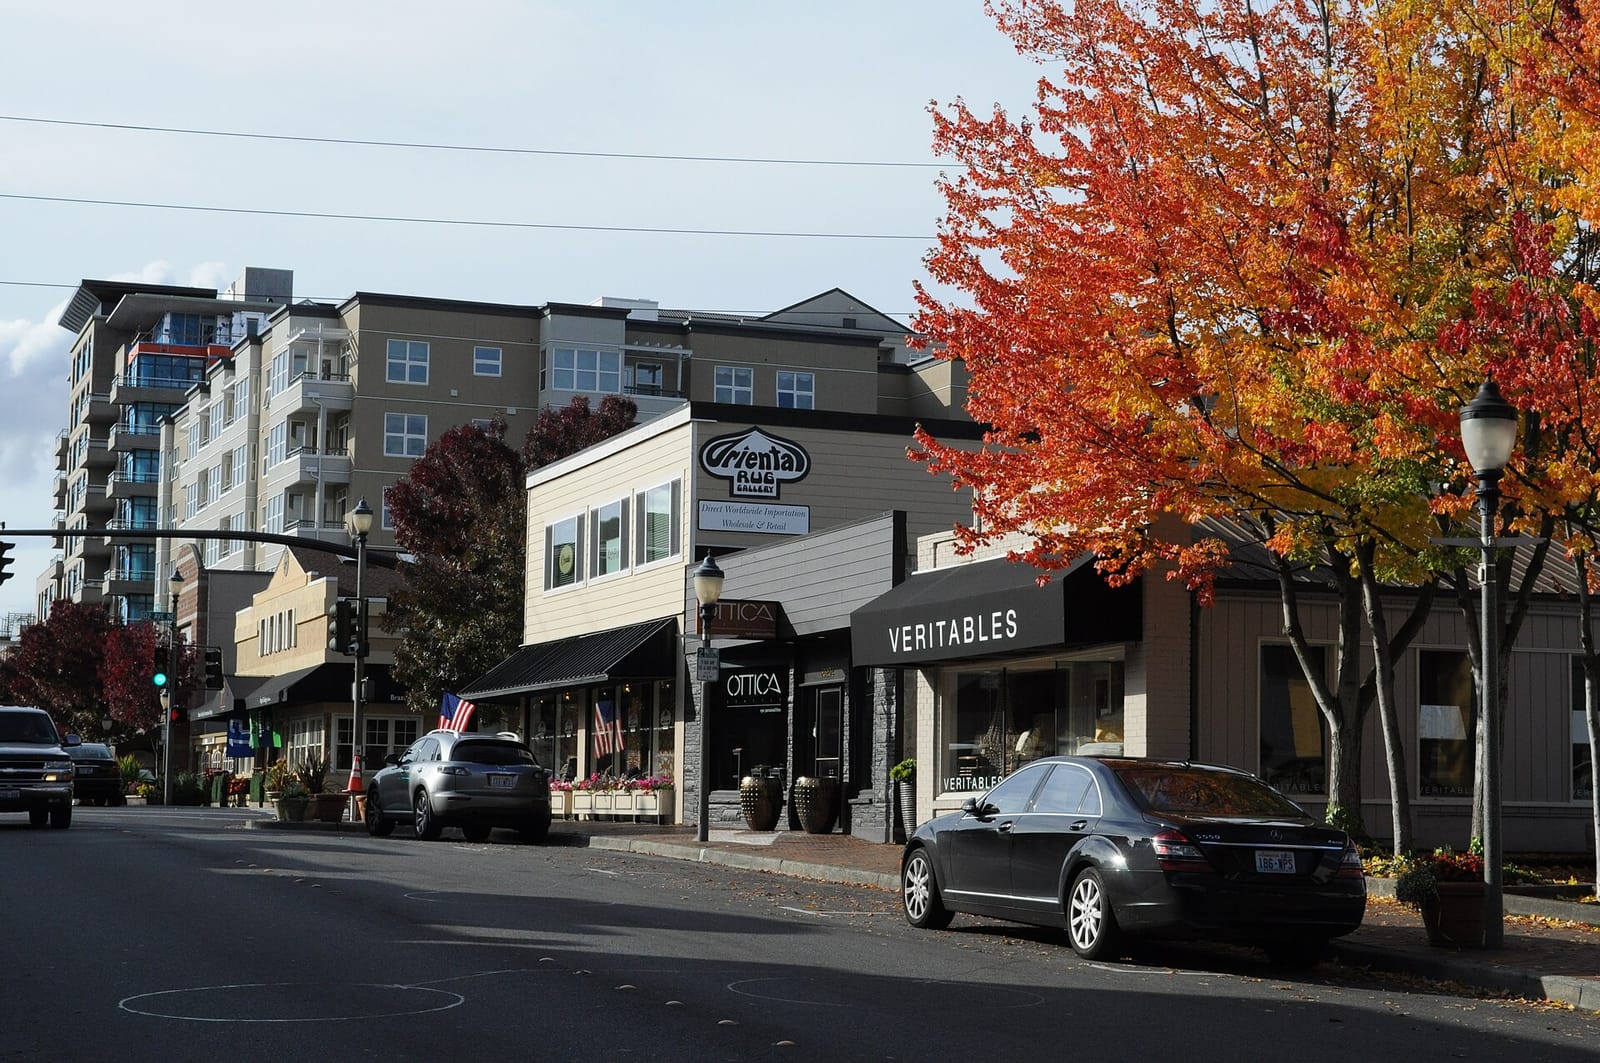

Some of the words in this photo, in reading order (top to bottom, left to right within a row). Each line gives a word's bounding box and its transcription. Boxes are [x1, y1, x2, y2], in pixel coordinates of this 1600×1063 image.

[706, 434, 806, 473] Oriental
[736, 470, 775, 485] RUG
[736, 485, 775, 494] GALLERY
[701, 503, 723, 513] Direct
[725, 504, 762, 516] Worldwide
[764, 507, 806, 519] Importation
[721, 519, 754, 530] Wholesale
[756, 520, 765, 530] &
[766, 521, 787, 531] Retail
[888, 608, 1019, 653] VERITABLES
[727, 672, 782, 697] OTTICA
